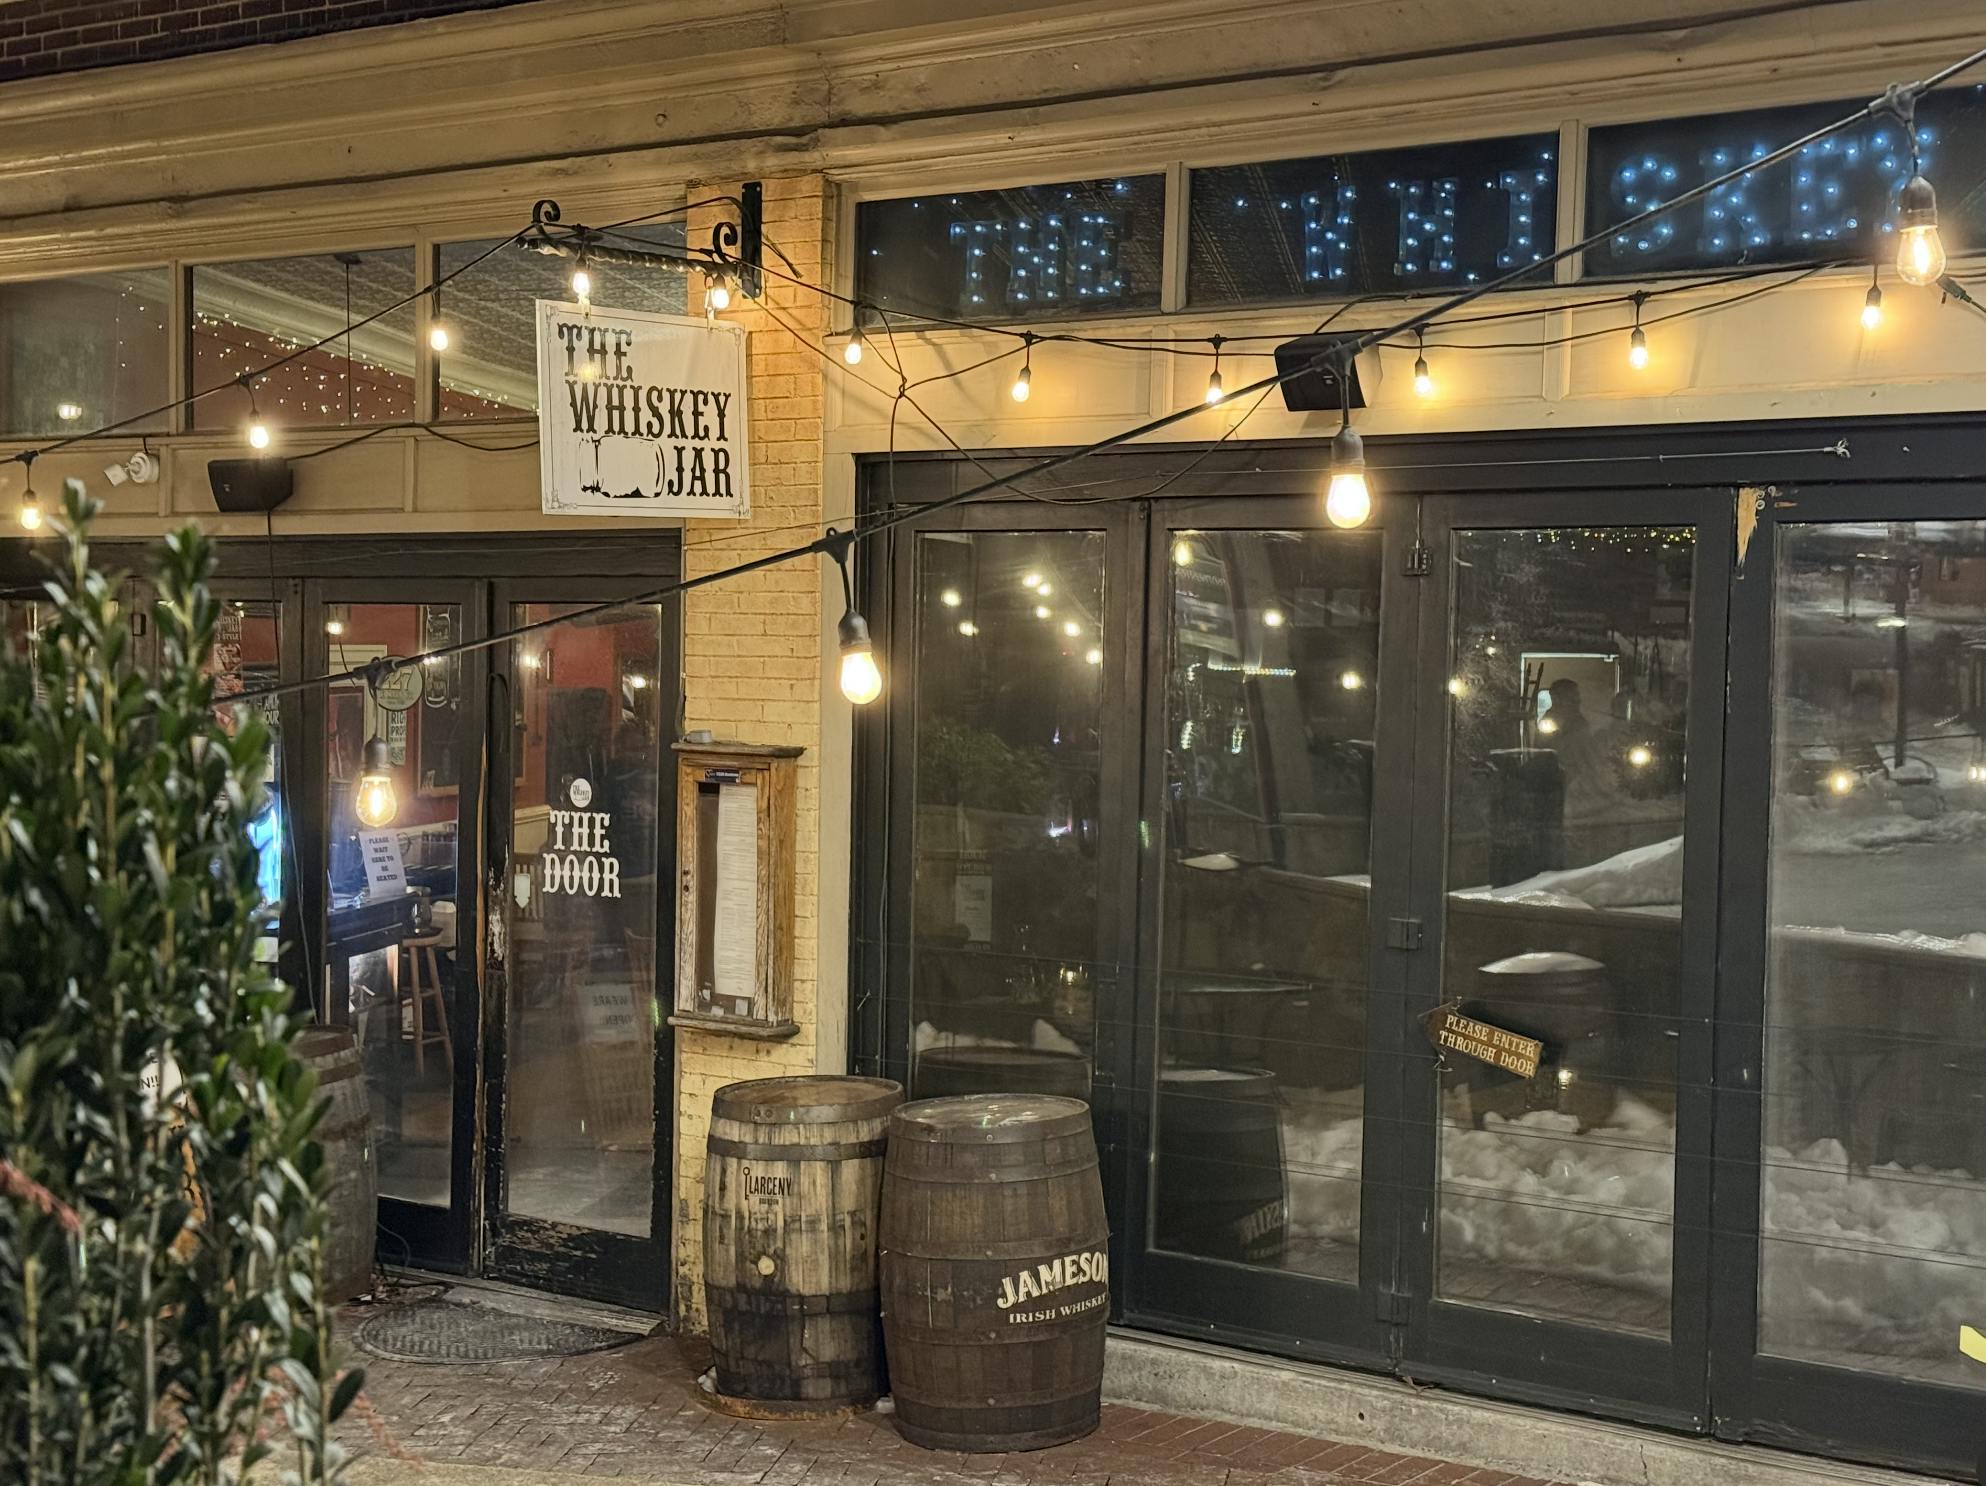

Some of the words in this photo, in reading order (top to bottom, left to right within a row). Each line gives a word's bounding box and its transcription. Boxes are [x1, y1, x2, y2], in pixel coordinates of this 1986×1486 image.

[950, 206, 1124, 305] THE
[557, 322, 633, 382] THE
[565, 380, 731, 442] WHISKEY
[667, 446, 733, 498] JAR
[549, 809, 611, 853] THE
[542, 853, 621, 898] DOOR
[1439, 1030, 1497, 1063] THROUGH
[1500, 1051, 1536, 1076] DOOR
[1445, 1014, 1489, 1041] PLEASE
[1493, 1031, 1535, 1058] ENTER
[749, 1175, 792, 1196] LARCENY
[1009, 1309, 1056, 1324] IRISH
[1060, 1292, 1106, 1316] WHISKEY
